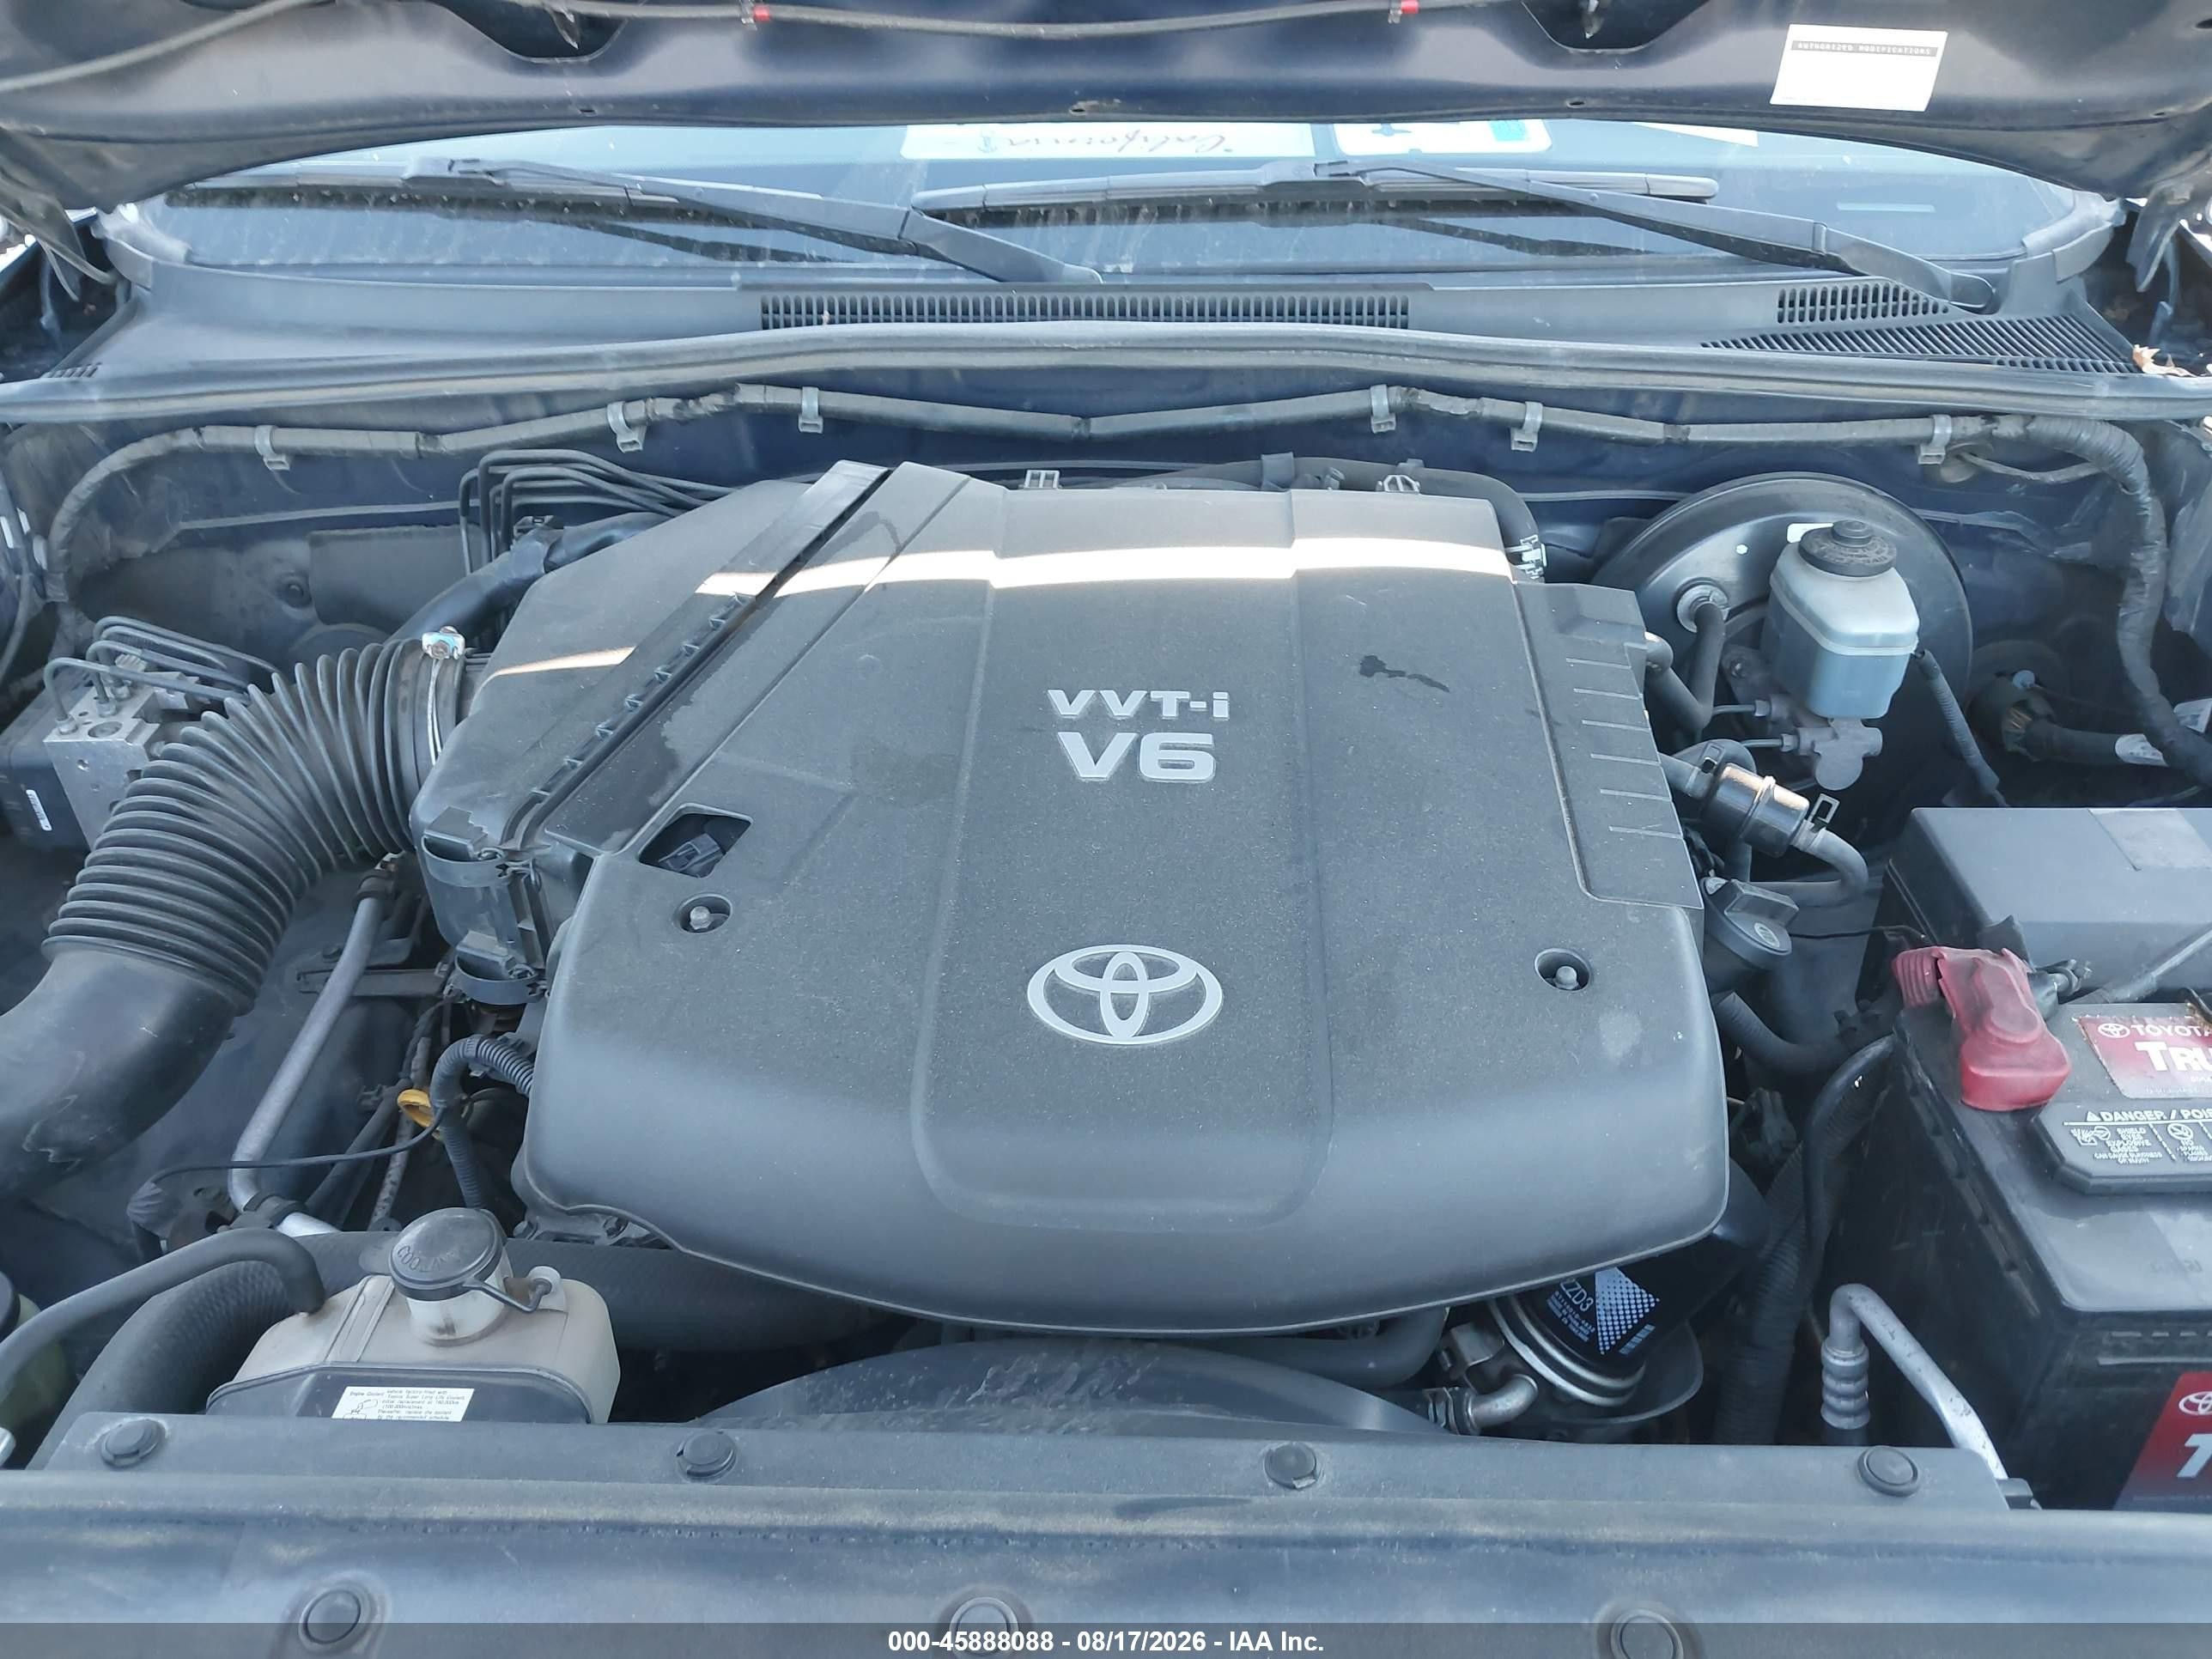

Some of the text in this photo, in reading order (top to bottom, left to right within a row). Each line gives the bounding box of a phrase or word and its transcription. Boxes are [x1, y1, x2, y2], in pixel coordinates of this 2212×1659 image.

[1797, 41, 1931, 55] AUTHORIZED MODIFICATIONS
[1048, 690, 1231, 720] VVT-i
[1057, 732, 1216, 782] V6
[2100, 1109, 2167, 1121] DANGER
